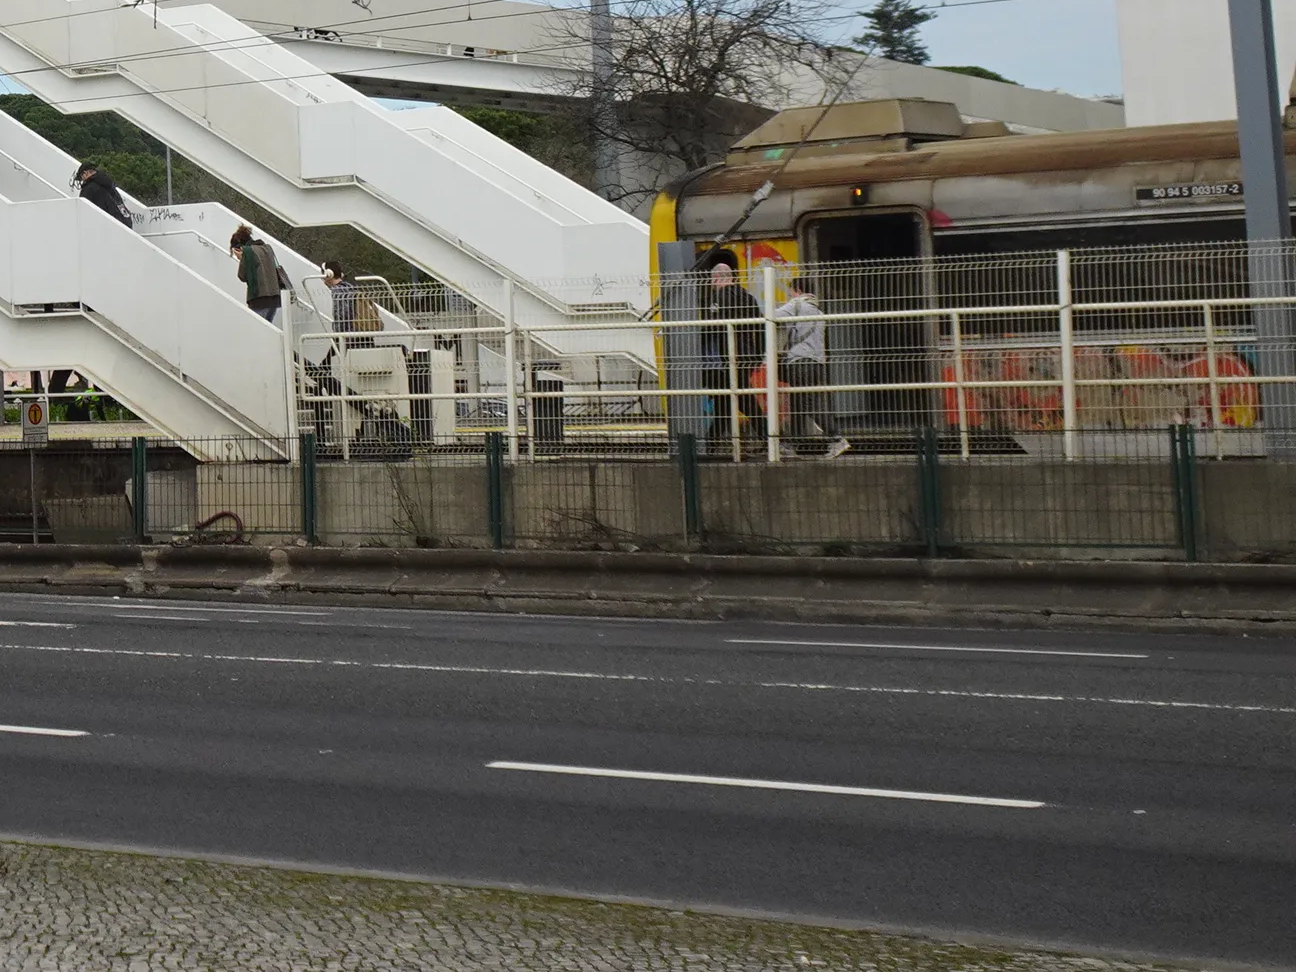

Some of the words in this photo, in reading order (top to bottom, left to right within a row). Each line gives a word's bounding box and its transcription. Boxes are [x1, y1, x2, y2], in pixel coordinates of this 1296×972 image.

[1152, 189, 1165, 198] 90
[1167, 188, 1180, 197] 94
[1182, 187, 1189, 196] 5
[1192, 184, 1239, 196] 003157-2
